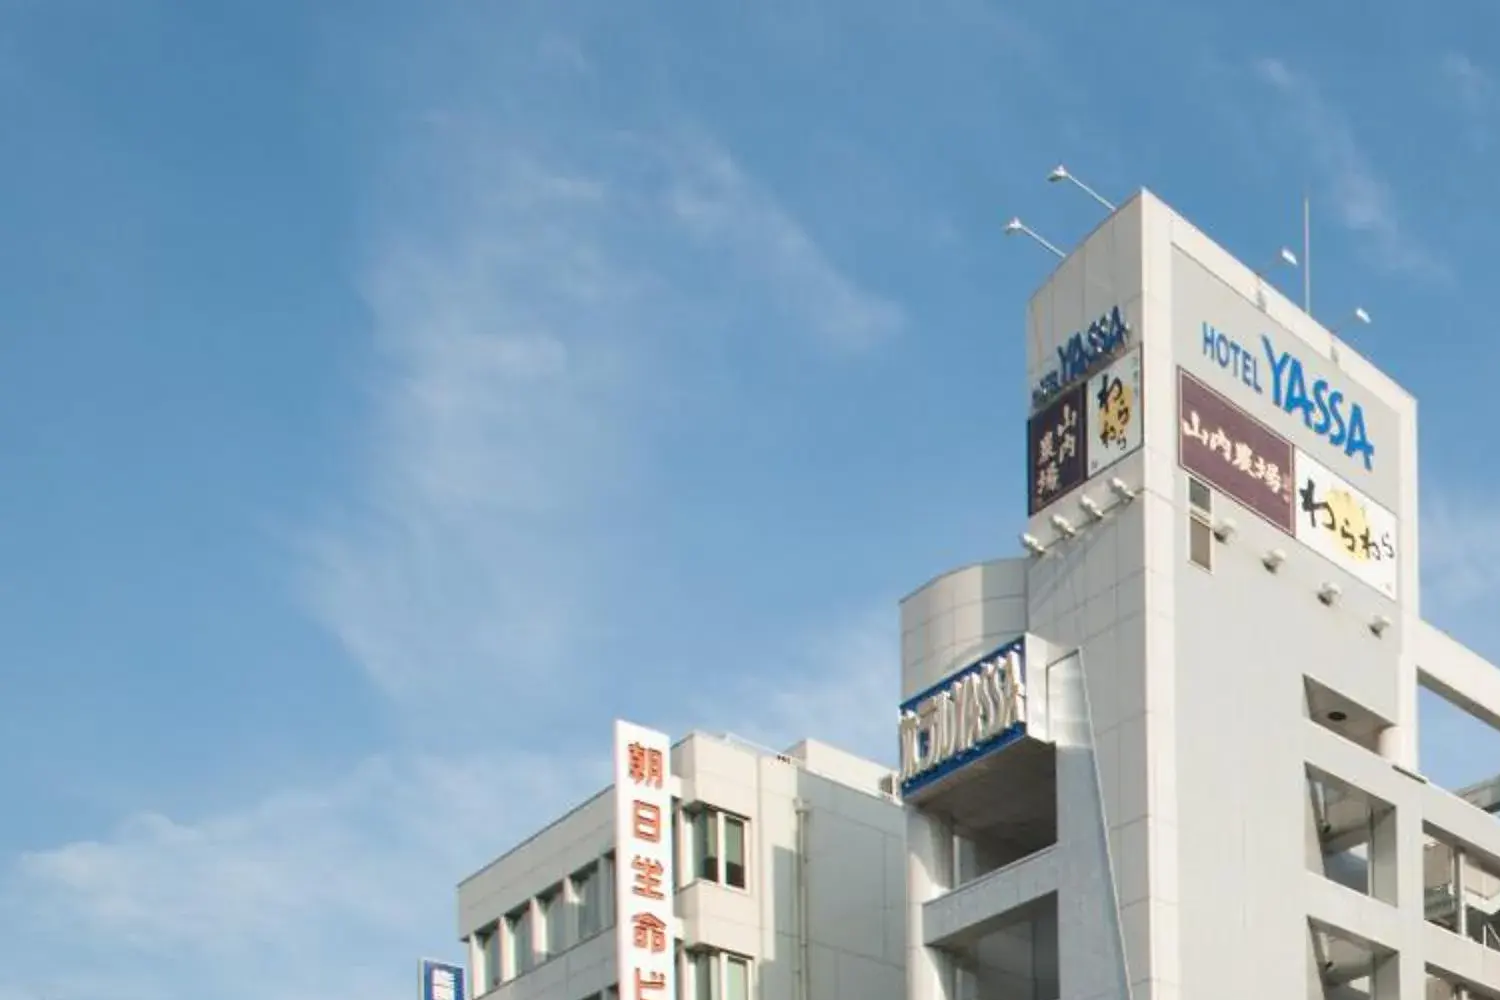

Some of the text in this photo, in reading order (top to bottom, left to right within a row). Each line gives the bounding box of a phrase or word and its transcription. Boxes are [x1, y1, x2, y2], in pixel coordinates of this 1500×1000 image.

[1202, 321, 1375, 472] HOTEL YASSA
[1299, 478, 1396, 561] わらわら
